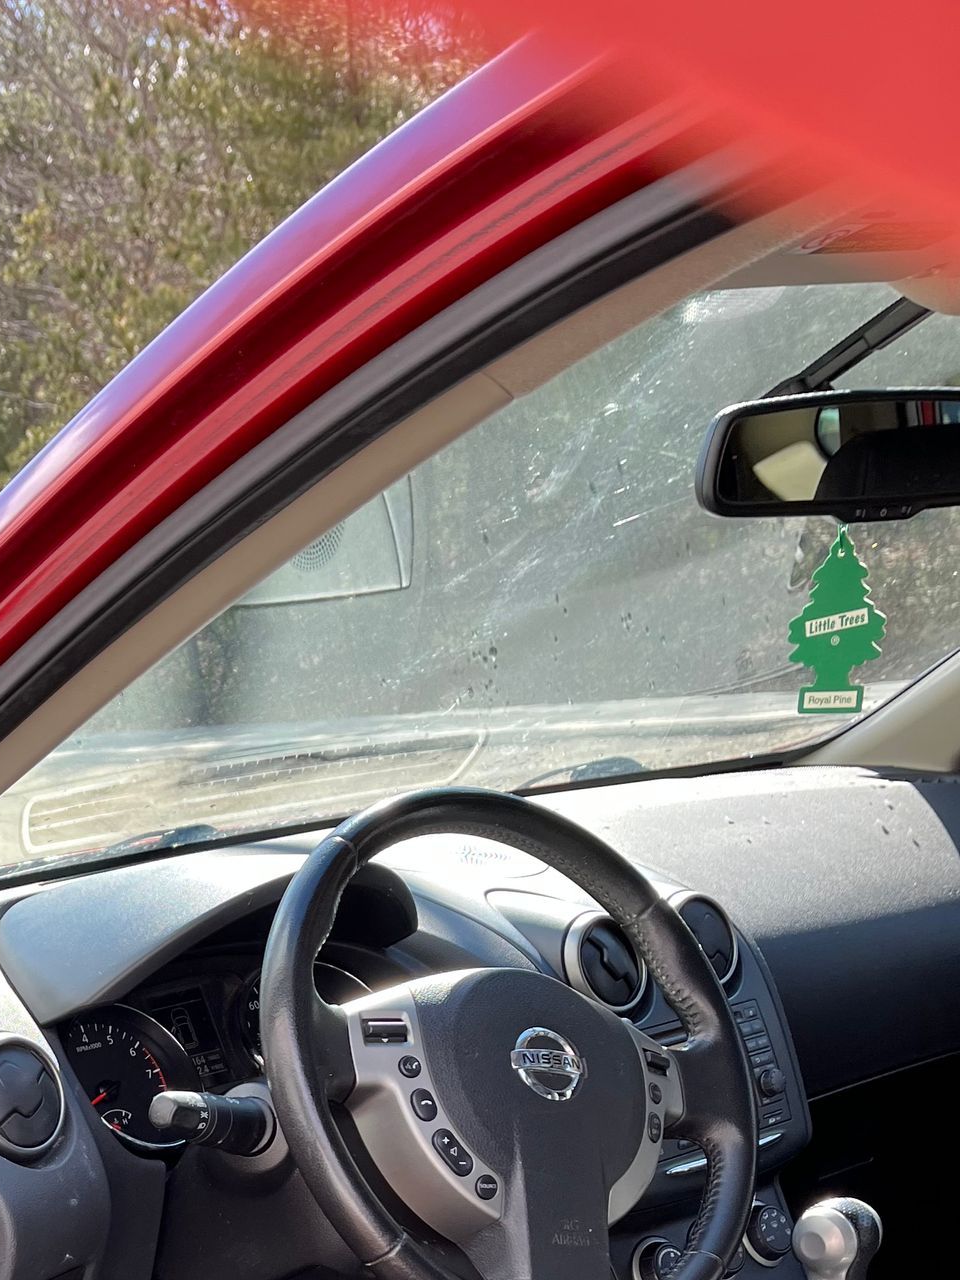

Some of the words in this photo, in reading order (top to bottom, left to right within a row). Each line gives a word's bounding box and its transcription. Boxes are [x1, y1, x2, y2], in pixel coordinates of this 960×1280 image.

[809, 618, 836, 634] Little
[838, 613, 865, 628] Trees
[808, 695, 832, 706] Royal
[833, 695, 852, 704] Pine
[248, 1000, 260, 1011] 60
[82, 1033, 89, 1043] 4
[106, 1035, 114, 1045] 5
[129, 1047, 137, 1057] 6
[522, 1053, 580, 1069] NISSAN
[145, 1069, 152, 1079] 7
